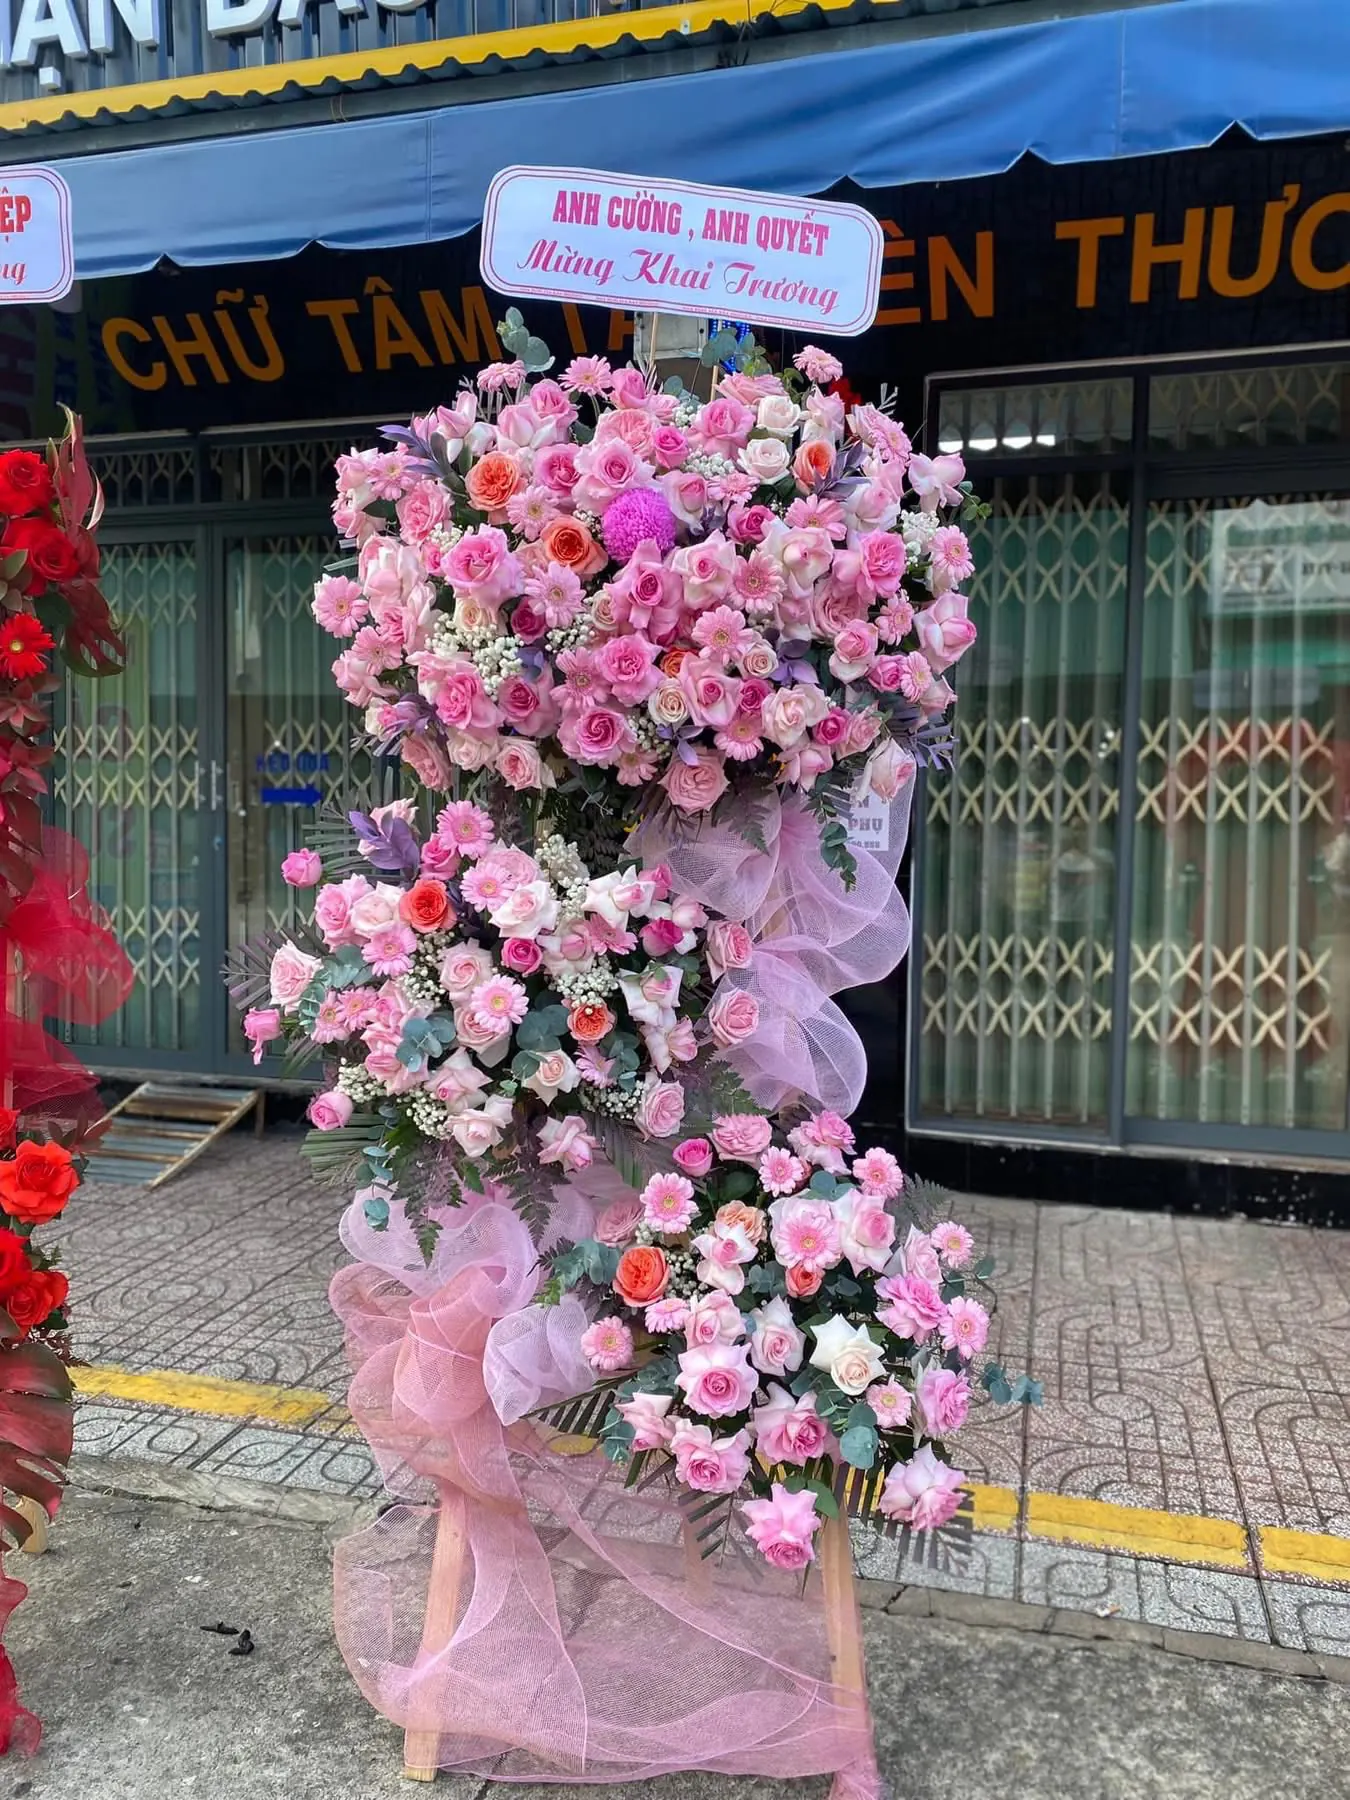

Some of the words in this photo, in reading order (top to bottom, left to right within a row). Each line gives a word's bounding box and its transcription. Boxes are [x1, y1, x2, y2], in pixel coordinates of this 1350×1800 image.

[552, 190, 602, 226] ANH
[607, 190, 683, 235] CƯỜNG
[702, 208, 750, 245] ANH
[756, 209, 830, 257] QUYẾT
[517, 238, 616, 286] Mừng
[622, 248, 711, 291] Khai
[723, 262, 840, 316] Trương
[101, 287, 286, 391] CHỮ
[305, 275, 501, 373] TÂM
